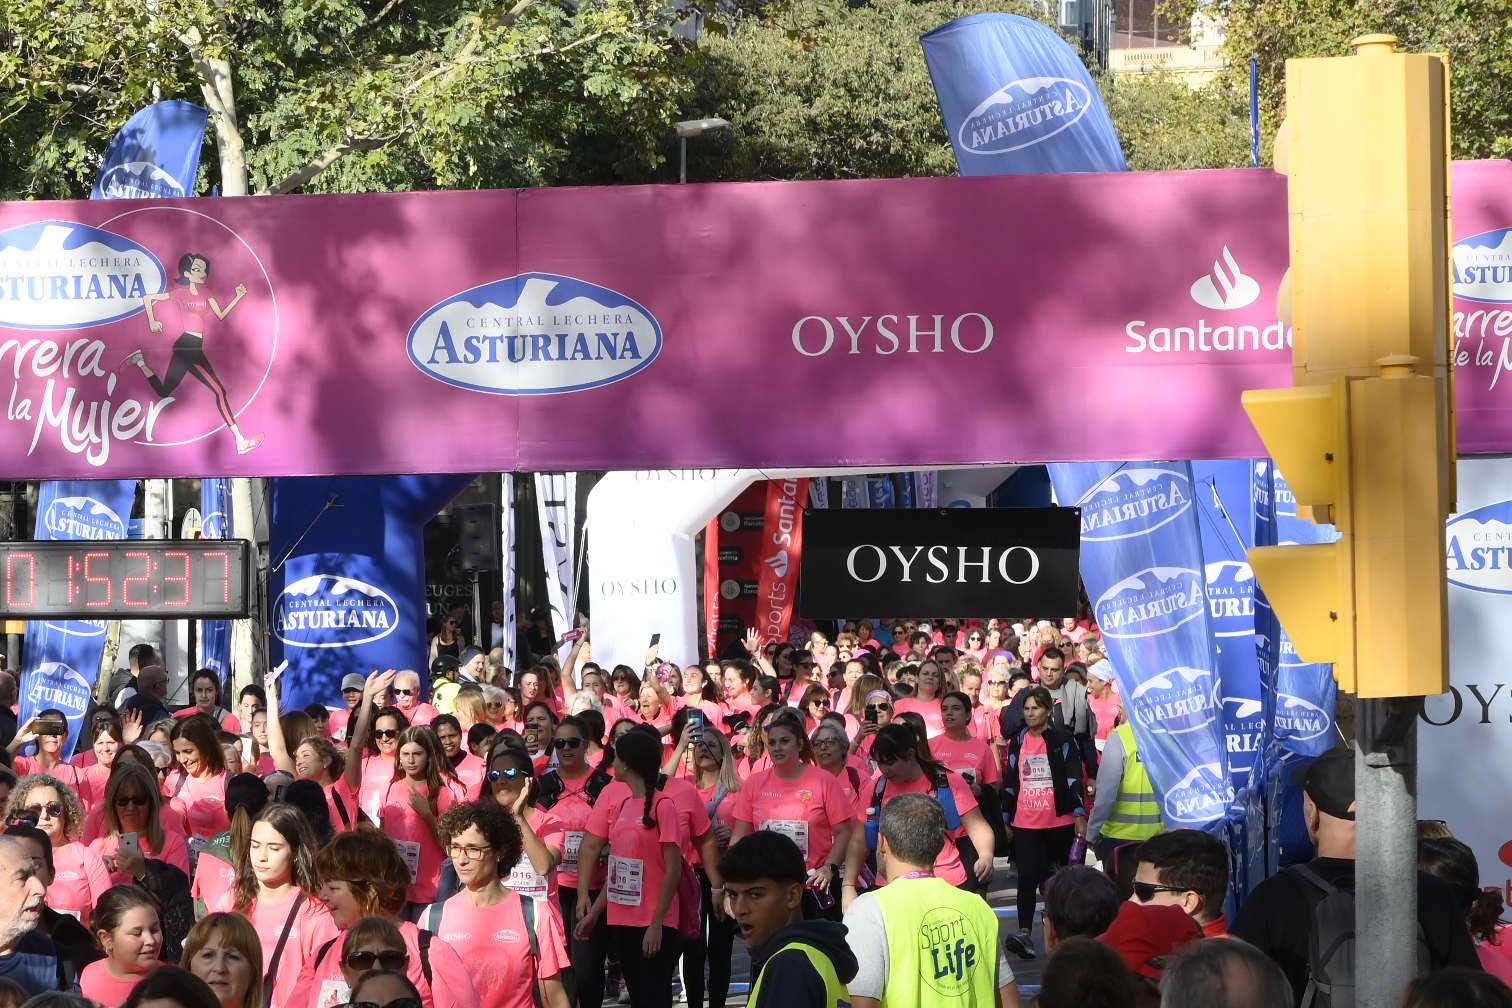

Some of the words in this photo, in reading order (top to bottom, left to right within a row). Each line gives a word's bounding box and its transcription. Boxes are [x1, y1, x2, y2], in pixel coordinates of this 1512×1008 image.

[69, 256, 142, 268] LECHERA
[466, 316, 545, 329] CENTRAL
[552, 313, 634, 326] LECHERA
[791, 312, 995, 357] OYSHO
[426, 320, 643, 365] ASTURIANA
[1475, 339, 1493, 366] la
[7, 380, 32, 421] la
[26, 371, 177, 467] Mujer
[6, 552, 230, 607] 01:52:37
[846, 543, 1040, 585] OYSHO
[276, 604, 390, 632] ASTURIANA
[289, 599, 332, 608] CENTRAL
[336, 599, 386, 607] LECHERA
[1418, 683, 1512, 727] OY
[512, 871, 532, 880] 016
[921, 915, 967, 950] Sport
[931, 938, 976, 982] Life
